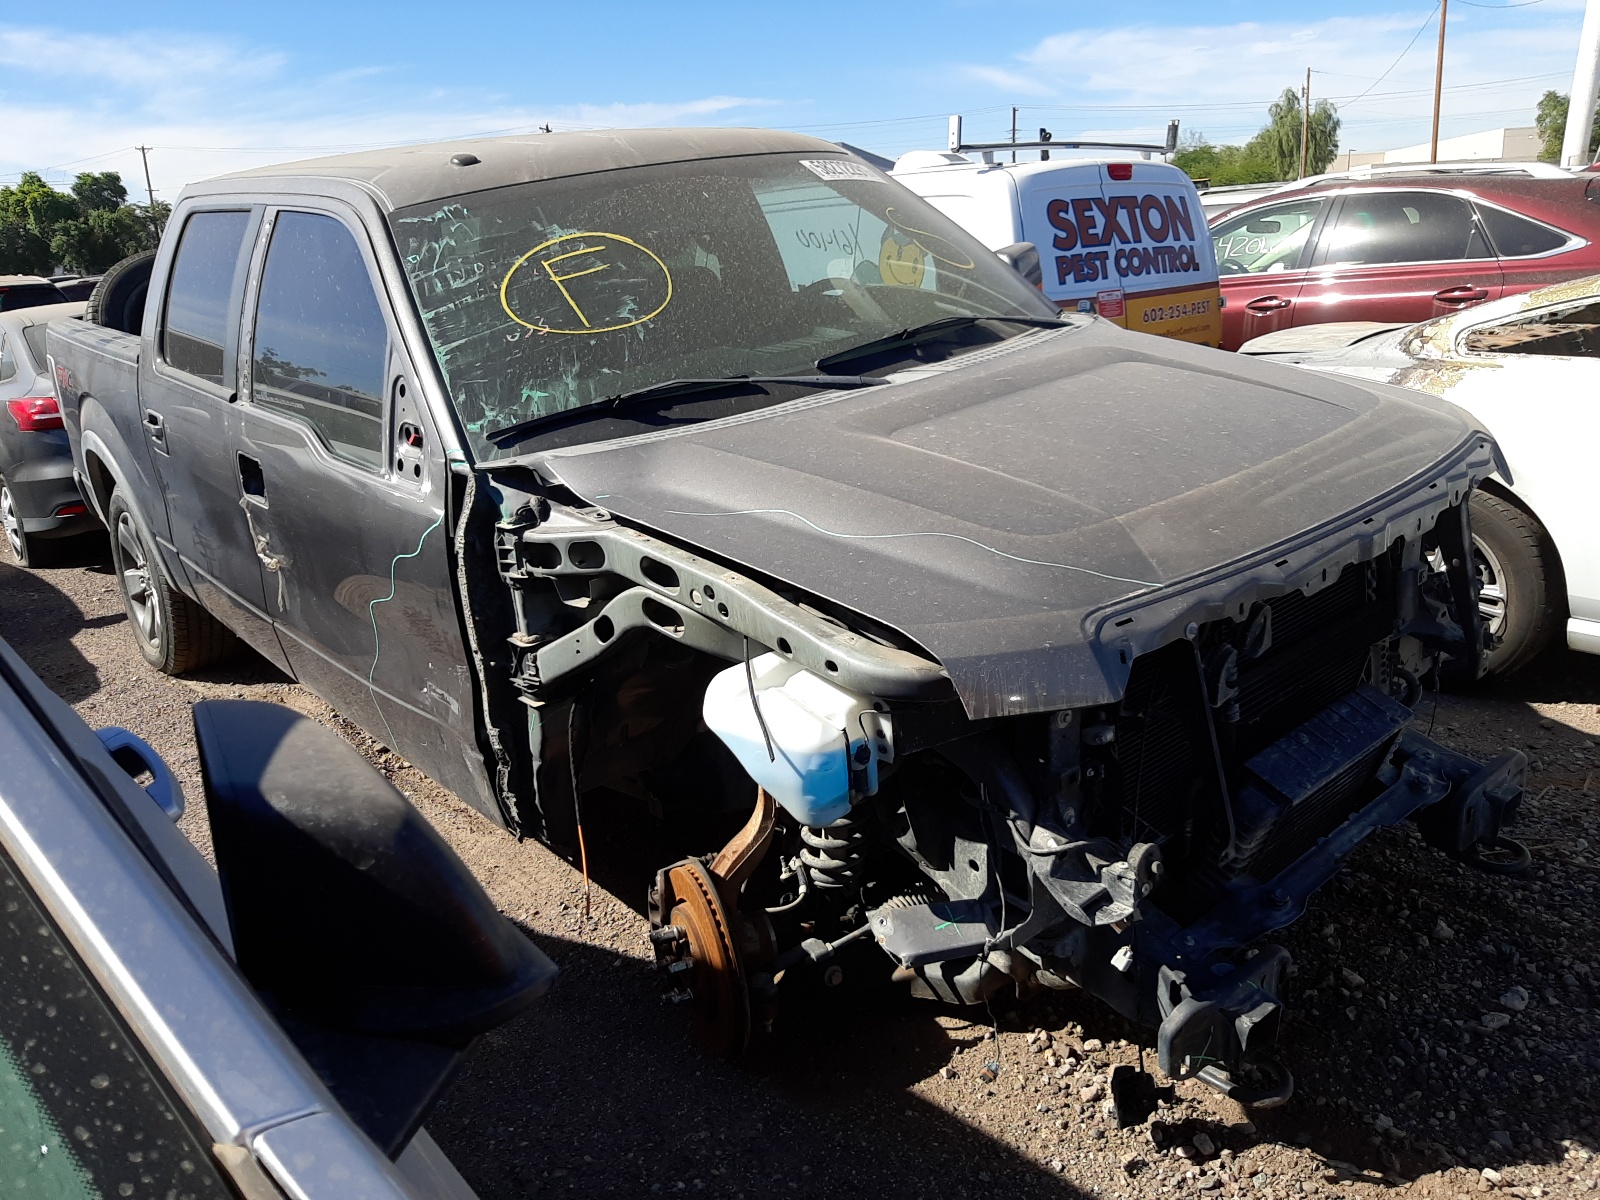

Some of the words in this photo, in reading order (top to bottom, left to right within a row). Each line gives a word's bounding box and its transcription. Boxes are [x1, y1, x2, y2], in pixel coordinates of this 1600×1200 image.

[1047, 195, 1195, 250] SEXTON
[541, 245, 610, 328] F
[1055, 251, 1109, 285] PEST
[1114, 245, 1200, 277] CONTROL
[1143, 300, 1210, 323] 602-254-PEST
